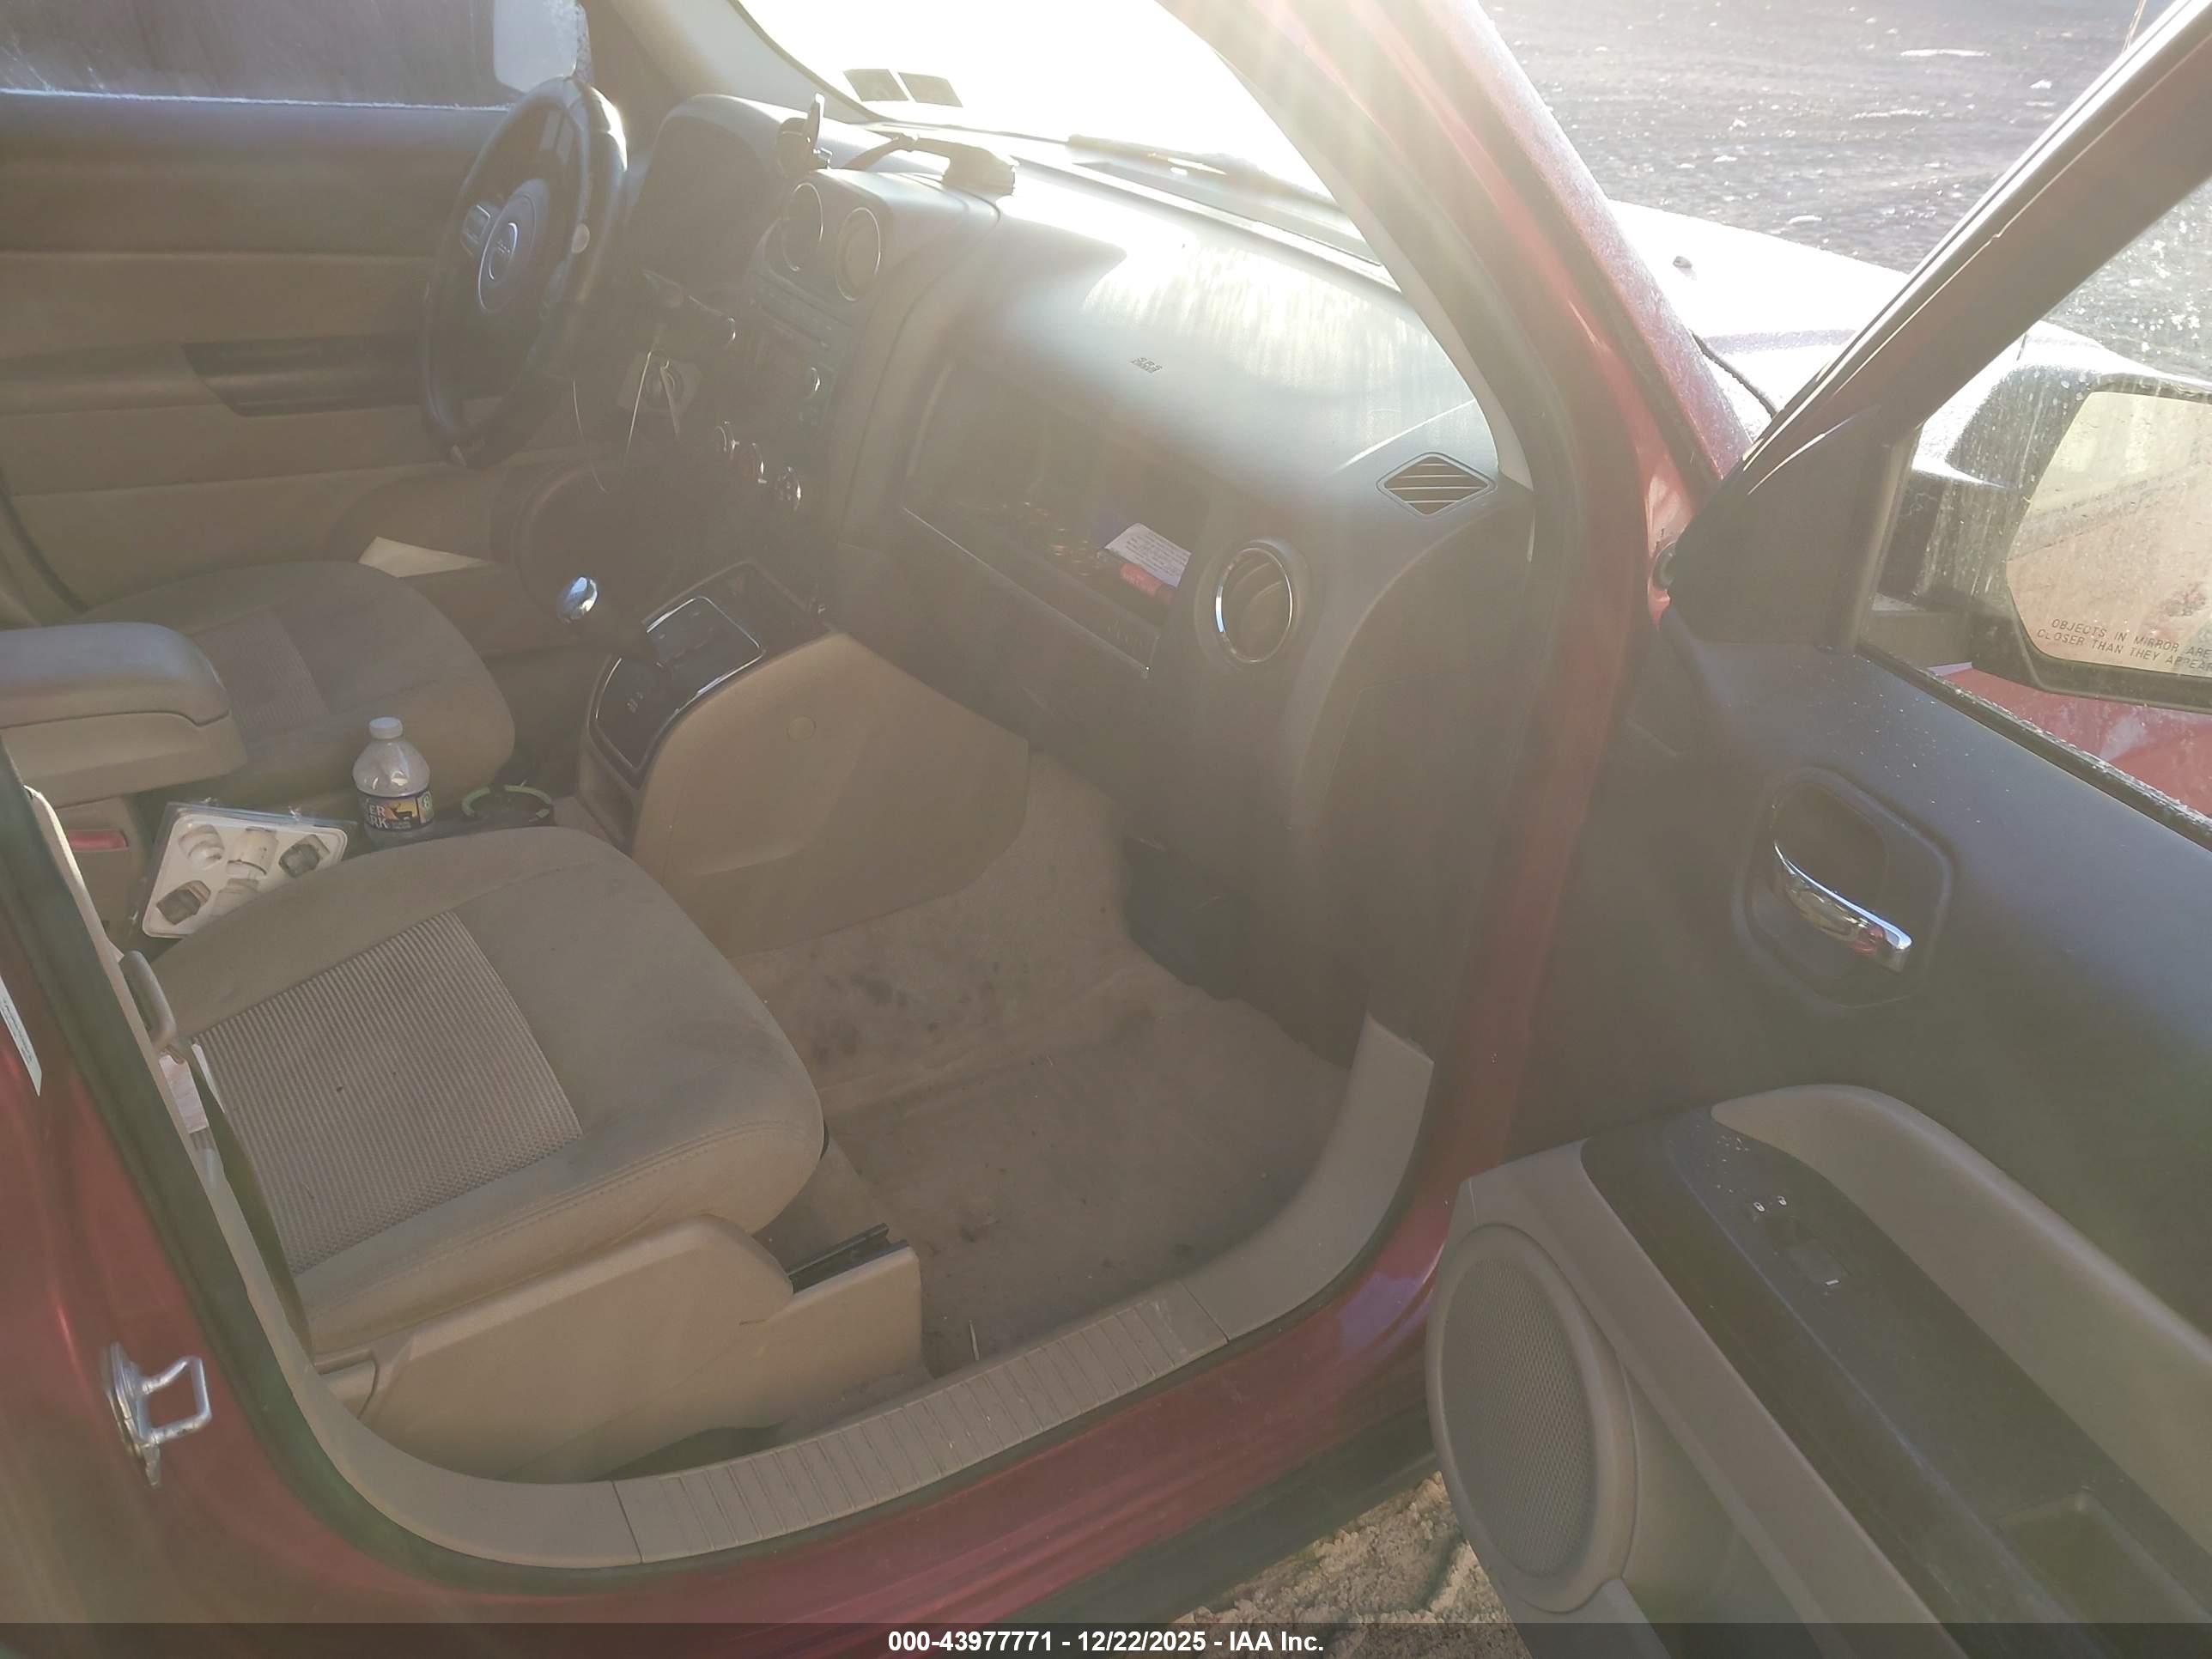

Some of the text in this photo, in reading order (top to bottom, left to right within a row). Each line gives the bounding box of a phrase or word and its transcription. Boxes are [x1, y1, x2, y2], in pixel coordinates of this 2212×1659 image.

[2037, 629, 2085, 645] CLOSER
[2092, 639, 2124, 654] THAN
[2130, 647, 2160, 660] THEY
[2051, 618, 2212, 659] OBJECTS IN MIRROR ARE
